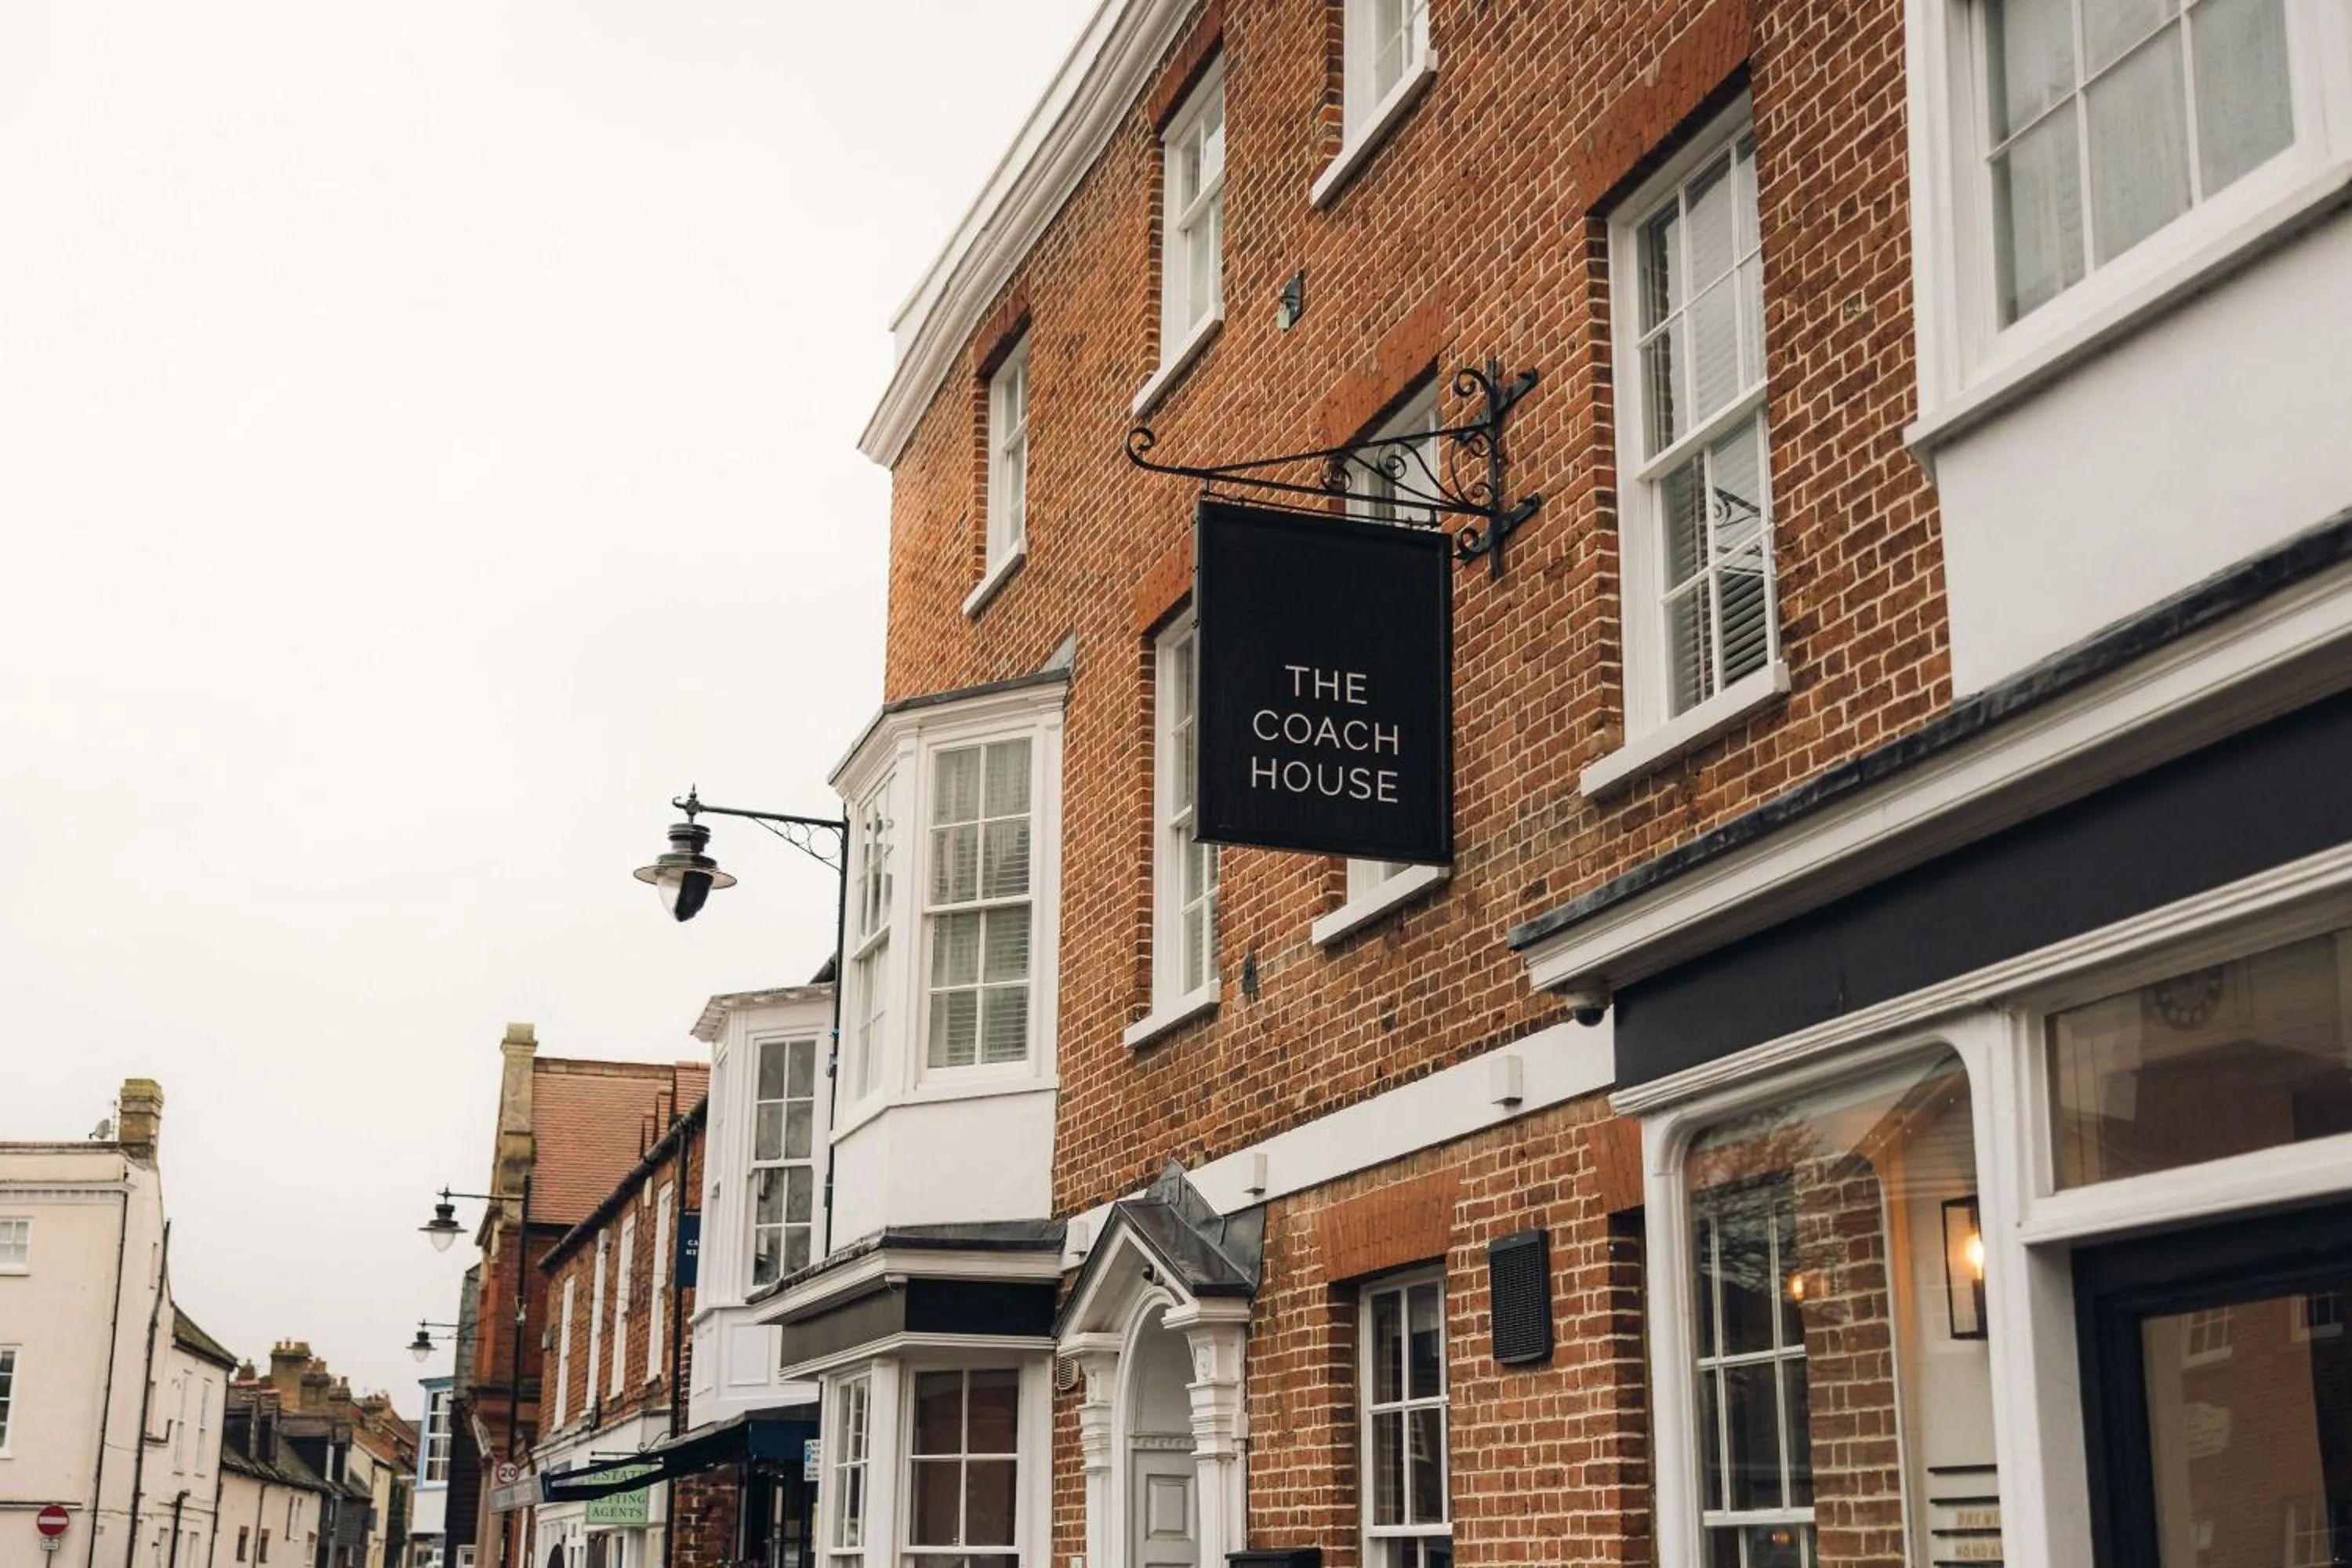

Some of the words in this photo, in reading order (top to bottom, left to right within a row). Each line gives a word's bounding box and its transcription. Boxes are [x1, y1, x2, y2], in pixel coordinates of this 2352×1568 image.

[1285, 665, 1367, 704] THE
[1253, 710, 1399, 754] COACH
[1251, 757, 1399, 803] HOUSE
[501, 1467, 517, 1478] 20
[592, 1491, 646, 1504] TTING
[592, 1508, 643, 1518] AGENTS
